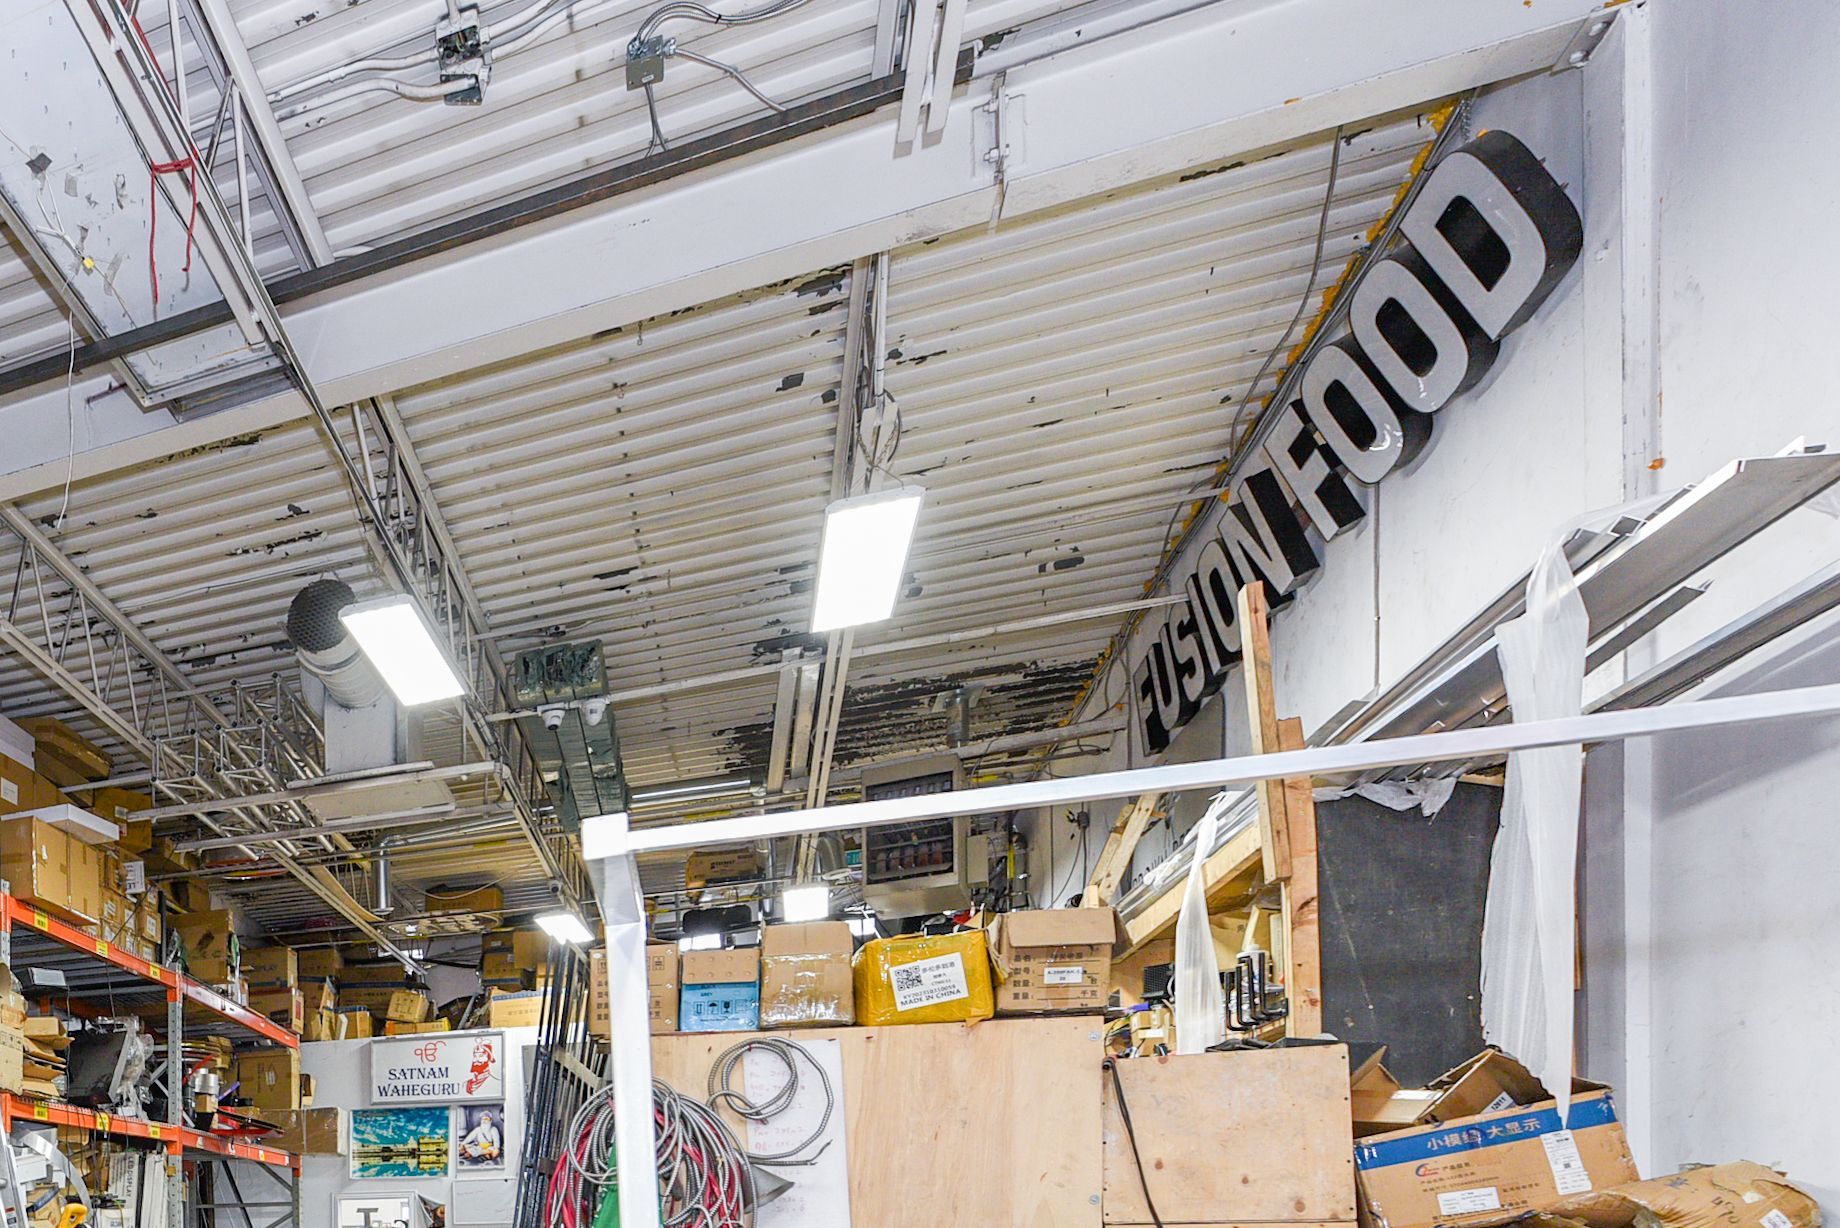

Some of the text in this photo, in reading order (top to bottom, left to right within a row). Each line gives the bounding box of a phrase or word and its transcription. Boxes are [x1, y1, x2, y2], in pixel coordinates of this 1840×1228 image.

[1132, 130, 1583, 757] FUSION FOOD
[900, 988, 961, 1008] MADE IN CHINA
[388, 1067, 449, 1081] SATNAM
[377, 1082, 461, 1098] WAHEGURU
[1486, 1118, 1541, 1139] 大显示
[126, 1170, 134, 1198] DISPLAY
